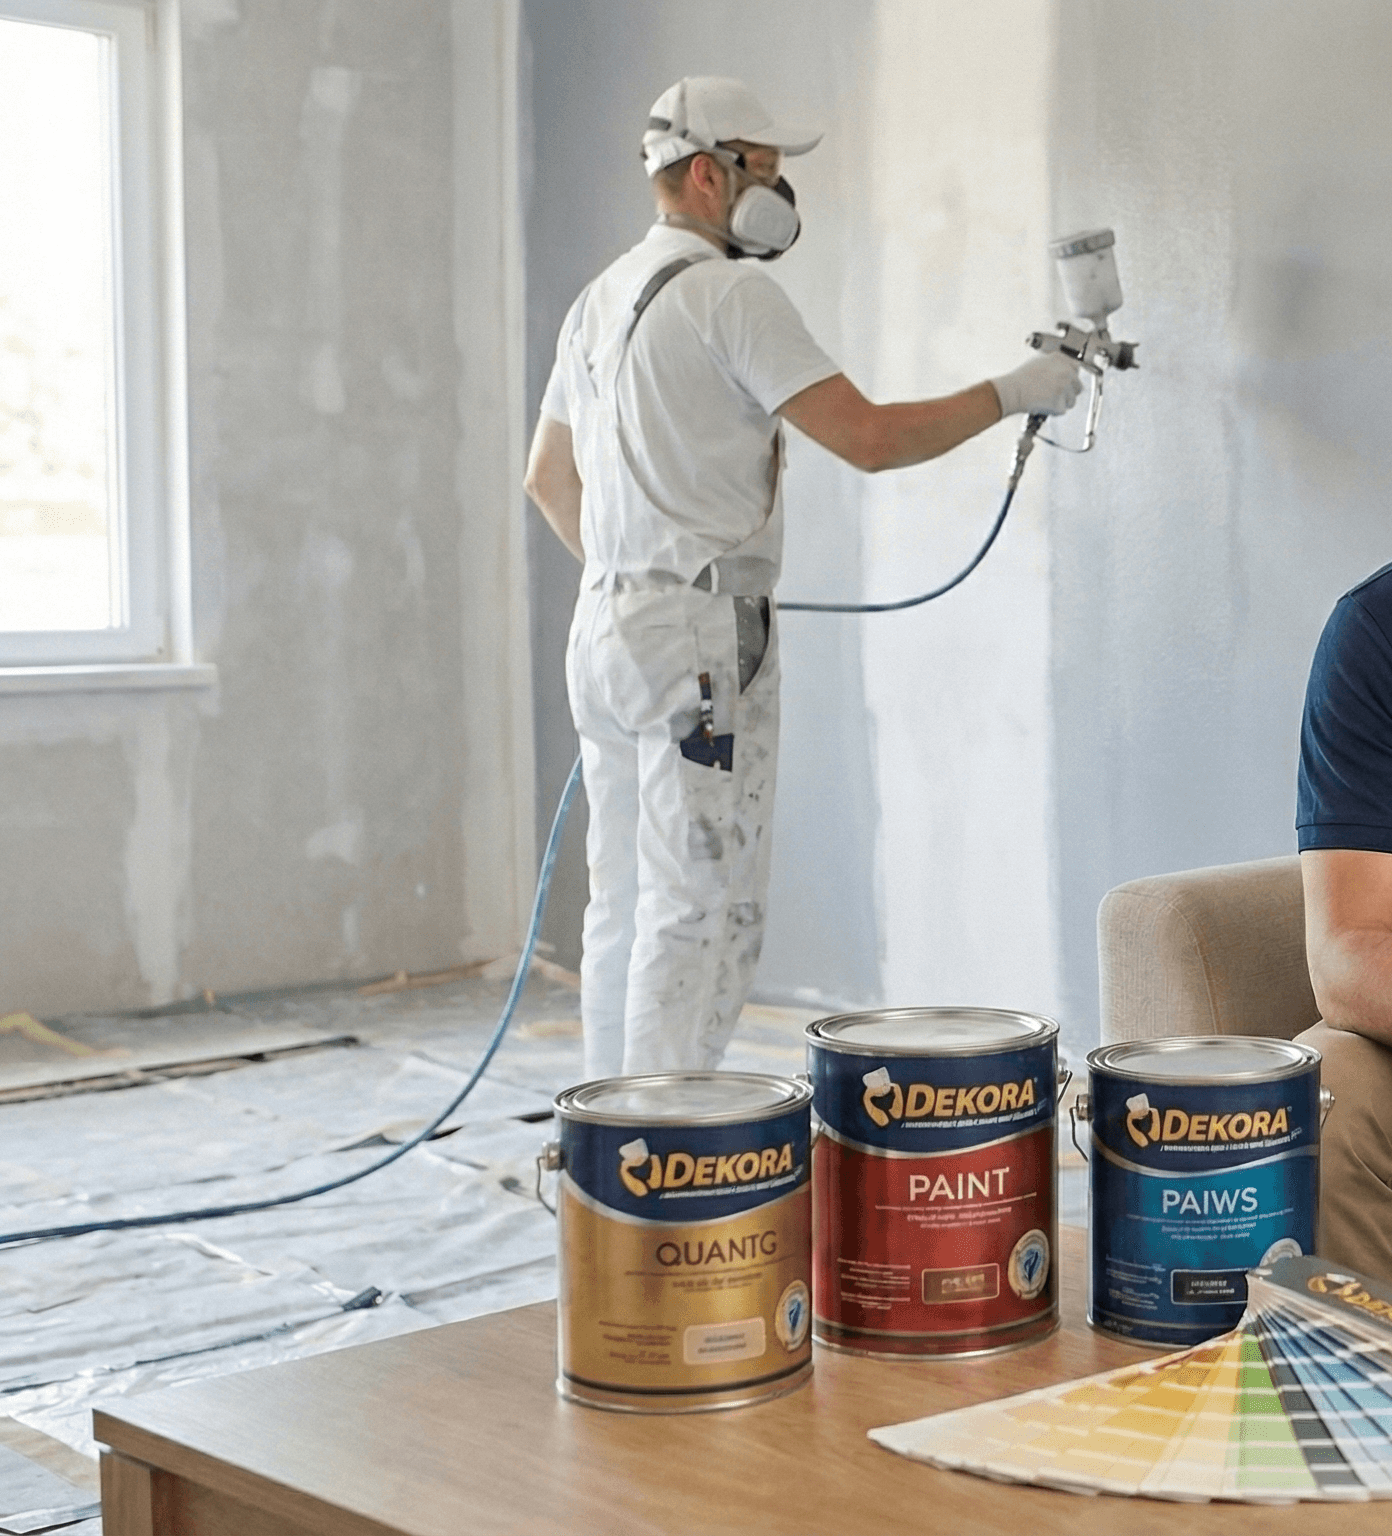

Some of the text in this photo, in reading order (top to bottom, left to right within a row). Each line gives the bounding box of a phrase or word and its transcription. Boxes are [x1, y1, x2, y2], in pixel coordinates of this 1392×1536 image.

[904, 1078, 1035, 1118] DEKORA
[1161, 1107, 1289, 1142] DEKORA
[662, 1142, 793, 1188] DEKORA
[909, 1166, 1010, 1202] PAINT
[1162, 1186, 1259, 1215] PAIWS
[655, 1230, 778, 1267] QUANTG
